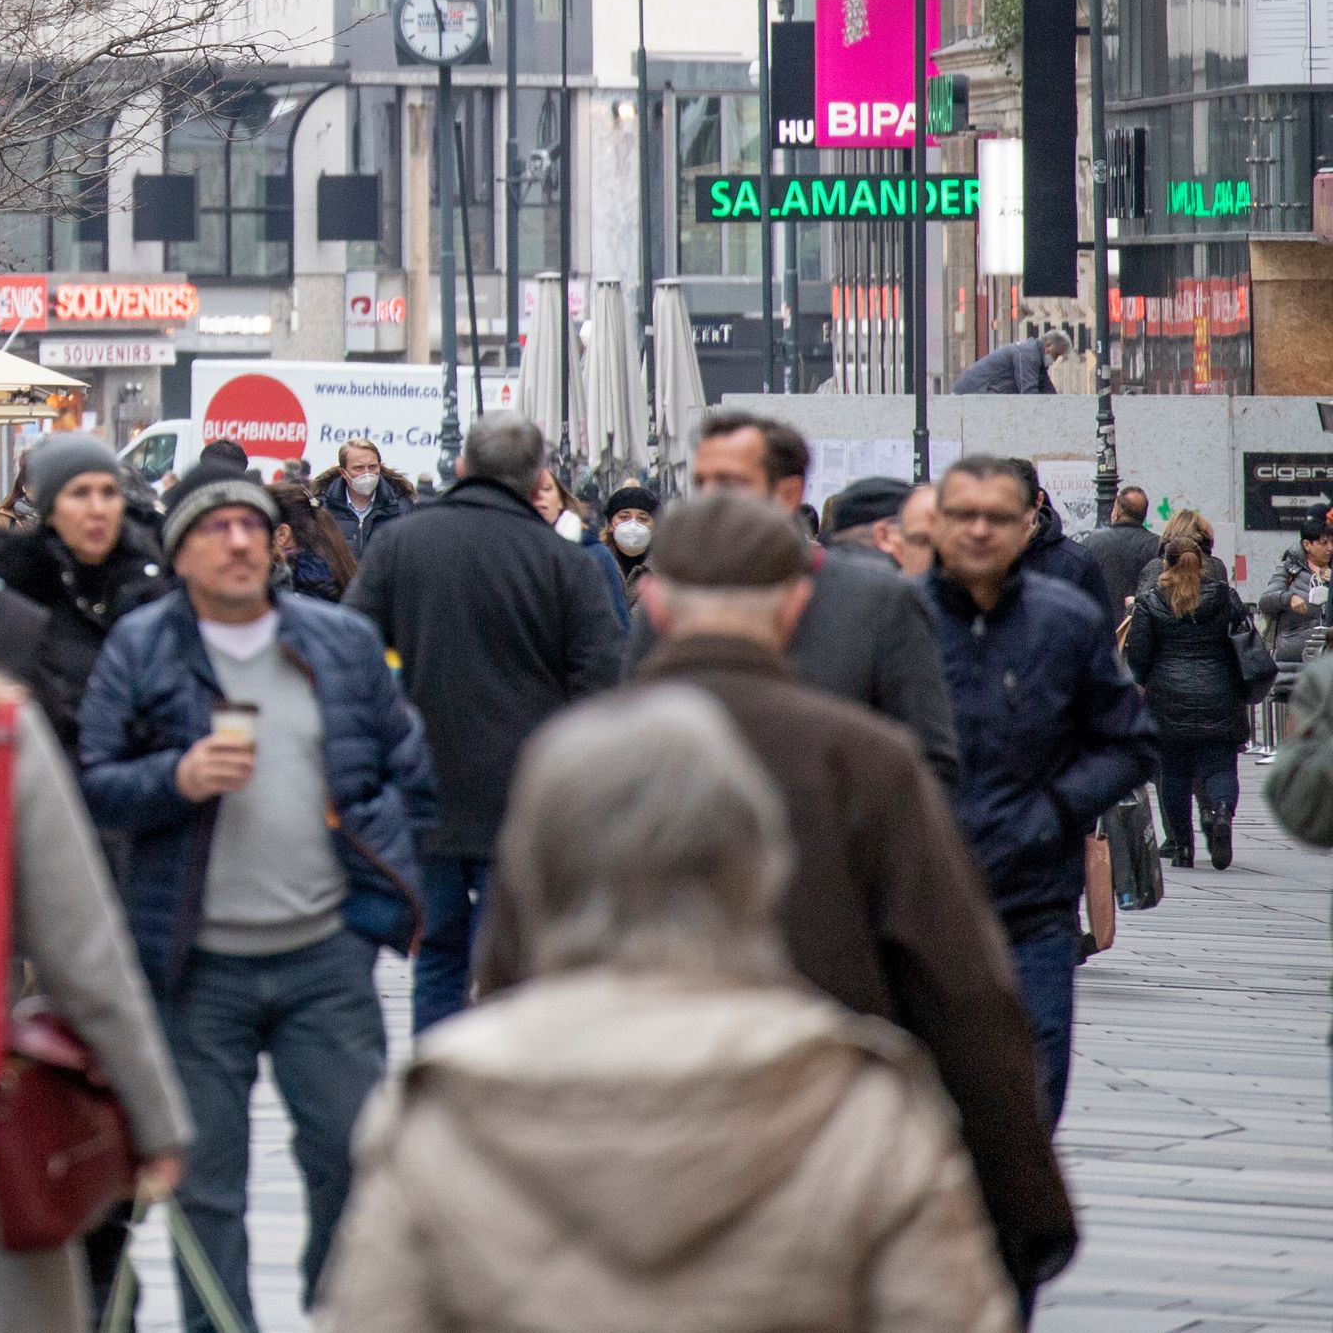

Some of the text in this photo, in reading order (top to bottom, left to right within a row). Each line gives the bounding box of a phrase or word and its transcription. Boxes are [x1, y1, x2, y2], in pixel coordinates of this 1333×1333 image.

[55, 283, 198, 321] SOUVENIRS
[63, 344, 152, 363] SOUVENIRS
[204, 419, 308, 443] BUCHBINDER
